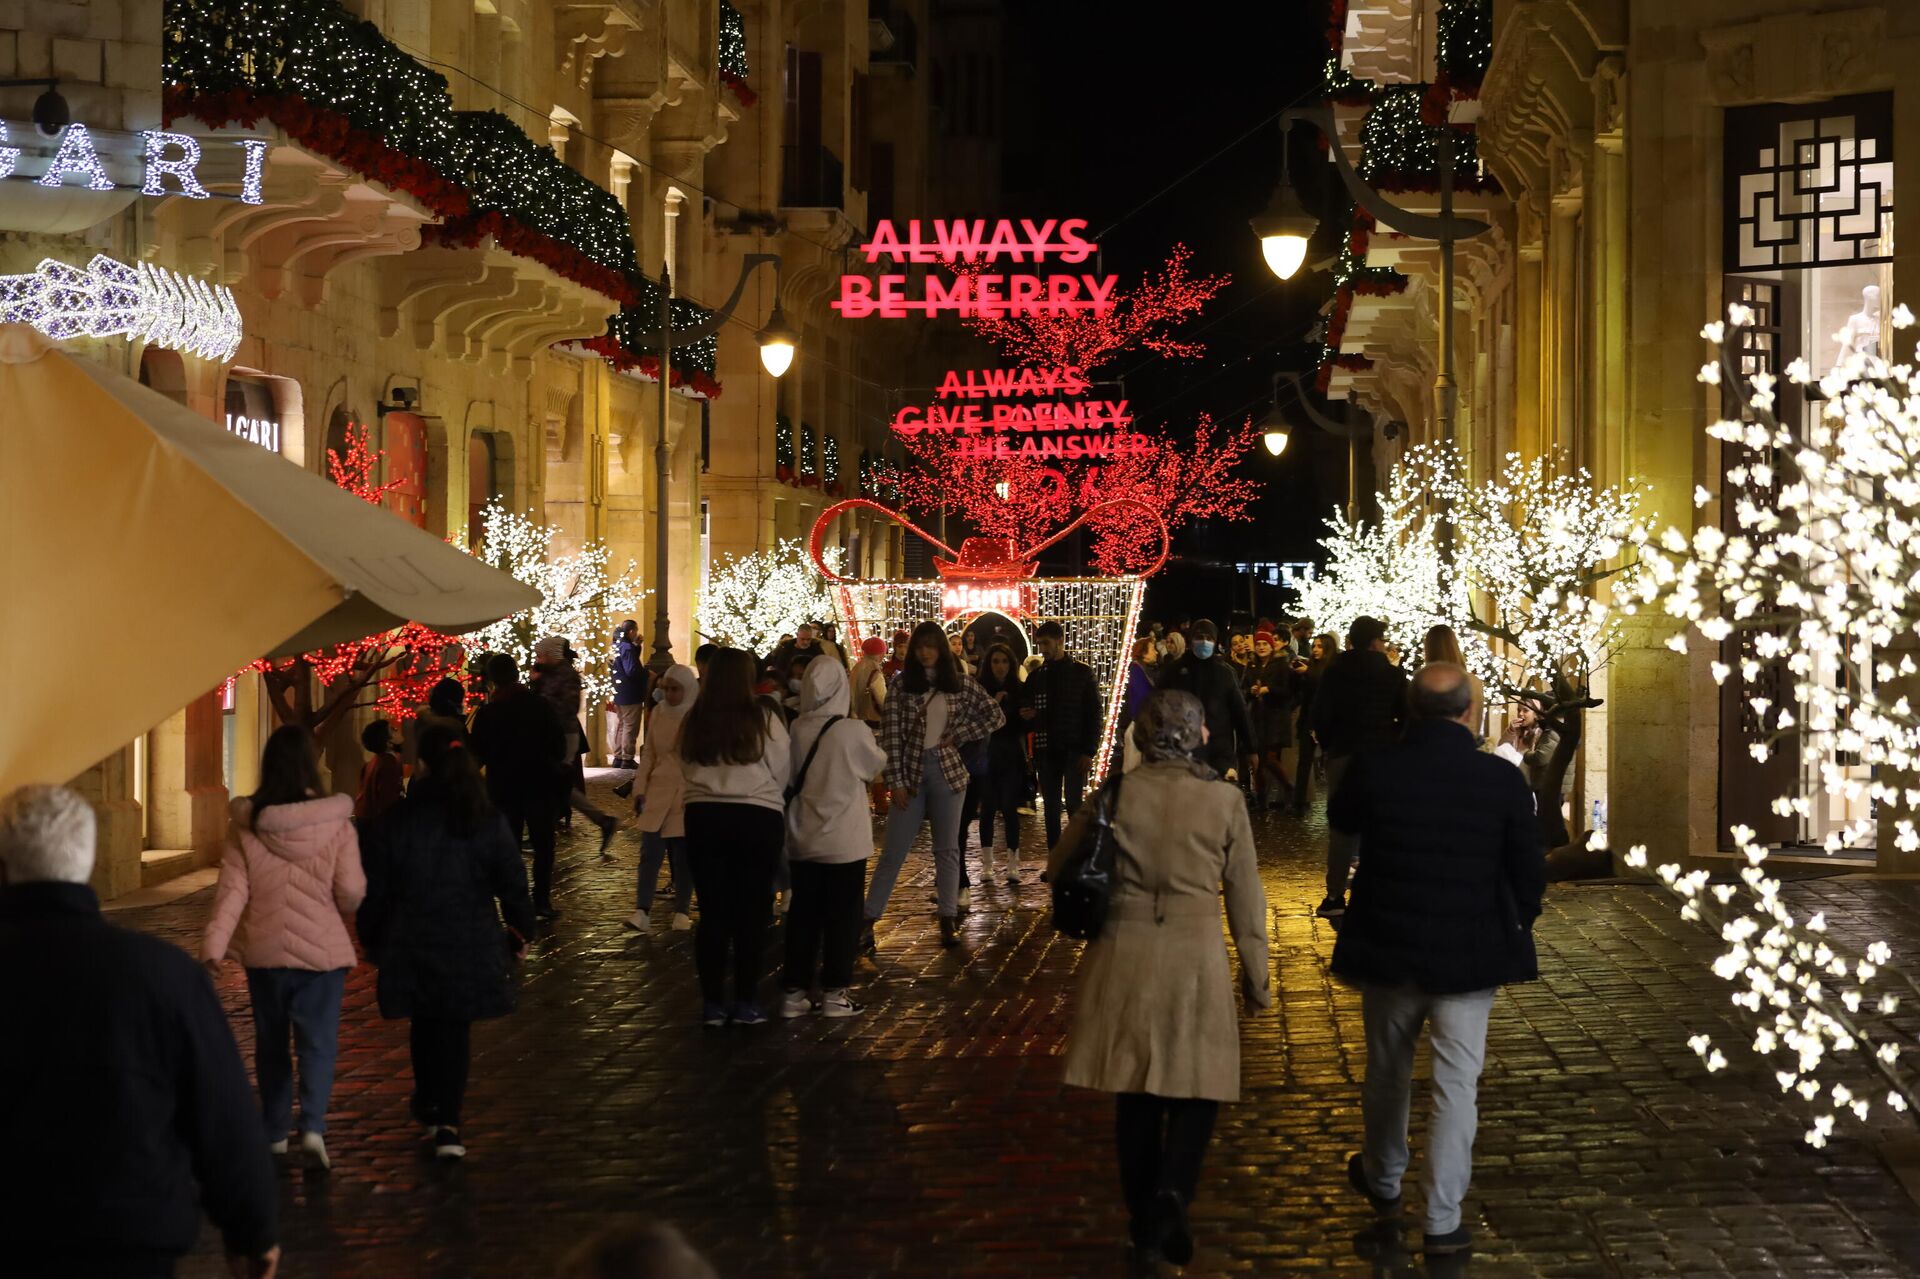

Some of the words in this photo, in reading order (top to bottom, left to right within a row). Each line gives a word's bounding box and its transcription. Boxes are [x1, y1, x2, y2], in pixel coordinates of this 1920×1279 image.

[866, 218, 1089, 264] ALWAYS
[840, 274, 907, 318] BE
[925, 274, 1119, 318] MERRY
[940, 366, 1082, 399] ALWAYS
[896, 404, 982, 435] GIVE
[993, 400, 1128, 432] PLENTY
[957, 436, 1010, 460] THE
[1020, 433, 1150, 460] ANSWER
